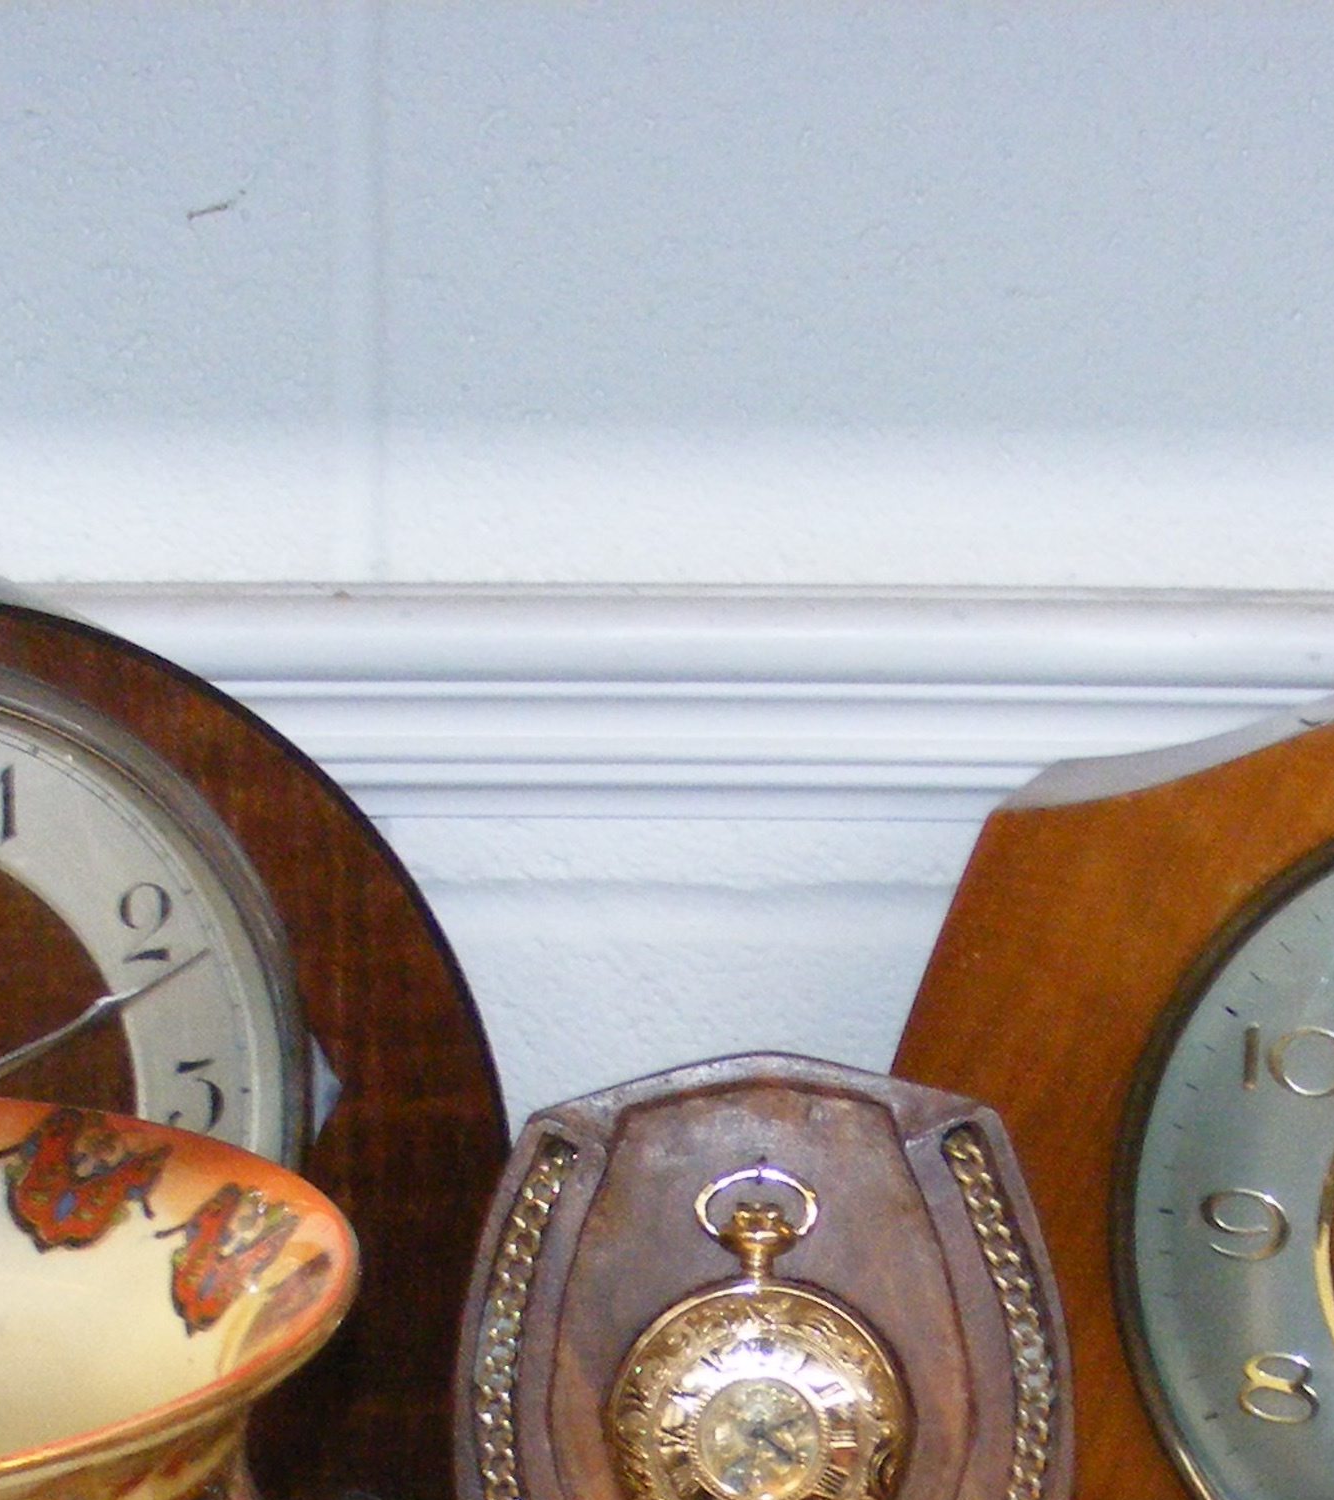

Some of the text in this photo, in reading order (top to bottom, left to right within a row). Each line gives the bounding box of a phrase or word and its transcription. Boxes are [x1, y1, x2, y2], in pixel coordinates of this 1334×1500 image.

[120, 883, 173, 962] 2
[1200, 1188, 1291, 1261] 9
[1238, 1353, 1320, 1423] 8
